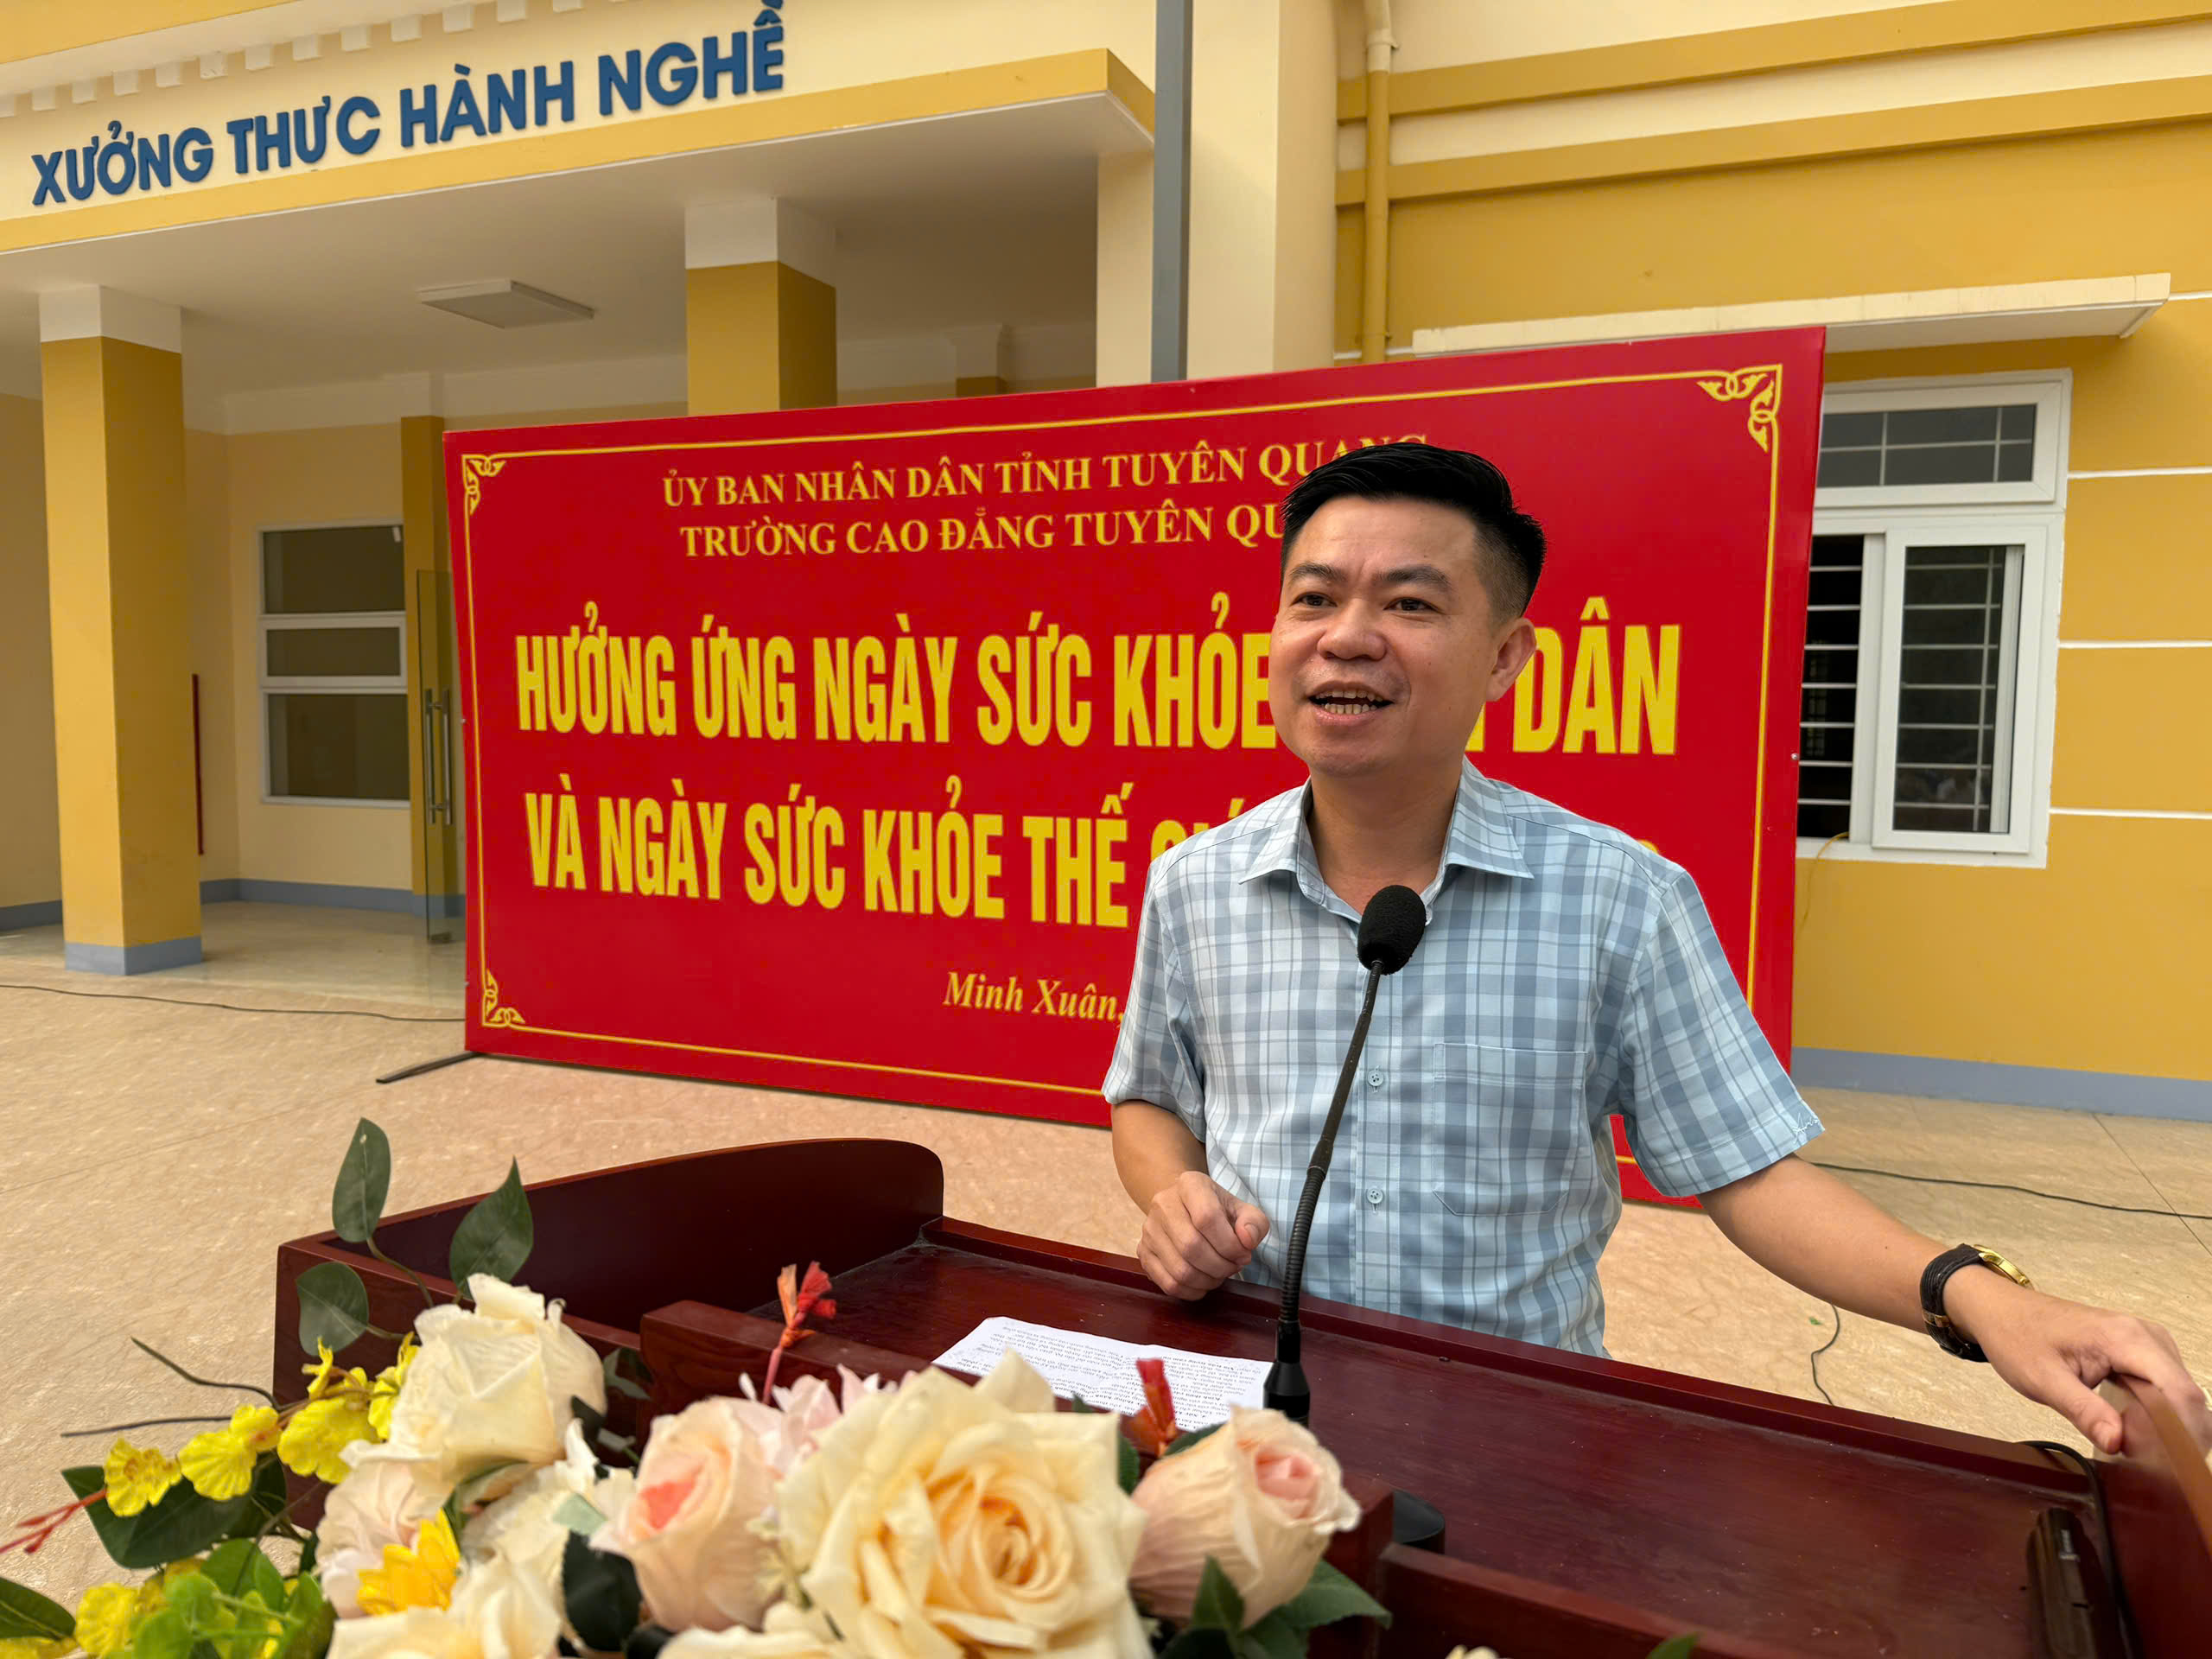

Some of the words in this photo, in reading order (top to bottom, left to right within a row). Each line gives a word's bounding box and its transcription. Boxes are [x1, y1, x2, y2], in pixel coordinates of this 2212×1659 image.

[32, 119, 213, 207] XƯỞNG
[399, 63, 575, 147] HÀNH
[598, 0, 784, 116] NGHỀ
[663, 469, 709, 506] ỦY
[717, 474, 785, 505] BAN
[796, 461, 895, 502] NHÂN
[906, 455, 983, 498] DÂN
[995, 451, 1091, 493] TỈNH
[1103, 440, 1247, 488] TUYÊN
[680, 515, 836, 556] TRƯỜNG
[846, 521, 929, 554] CAO
[1065, 499, 1214, 546] TUYÊN
[516, 601, 677, 736] HƯỞNG
[691, 614, 797, 741] ỨNG
[813, 613, 957, 743] NGÀY
[977, 611, 1092, 747] SỨC
[1114, 592, 1277, 750] KHỎE
[1513, 596, 1681, 754] DÂN
[524, 773, 587, 890] VÀ
[598, 779, 727, 899] NGÀY
[744, 784, 846, 909] SỨC
[863, 775, 1005, 919] KHỎE
[1022, 782, 1134, 928] THẾ
[943, 971, 1024, 1012] Minh
